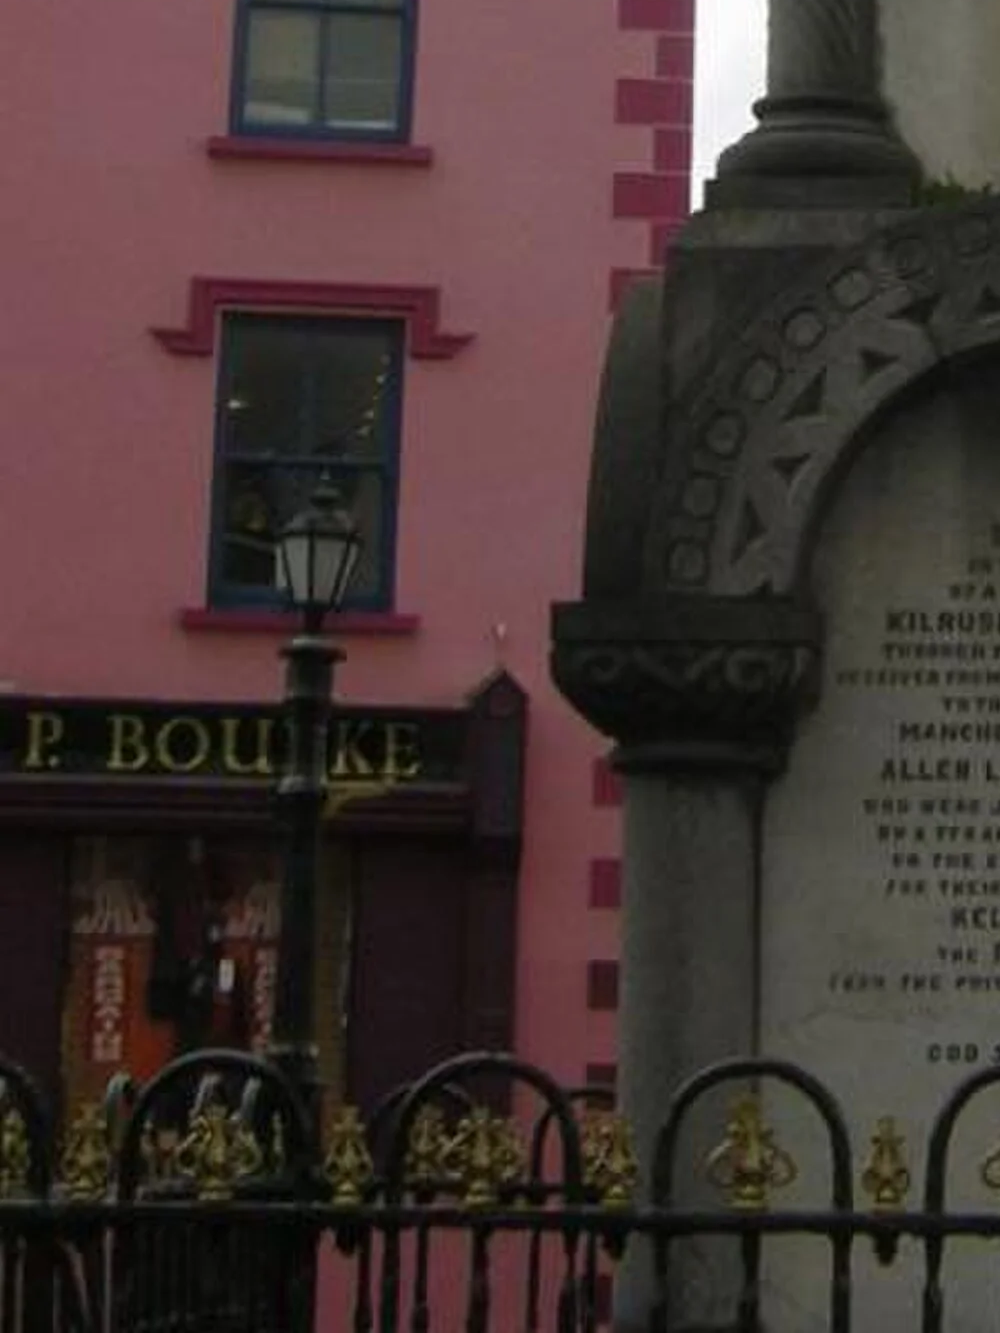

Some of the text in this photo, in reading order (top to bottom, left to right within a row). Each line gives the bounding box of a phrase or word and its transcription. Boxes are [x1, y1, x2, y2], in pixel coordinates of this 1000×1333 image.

[23, 710, 422, 777] P. BOUKE
[879, 758, 971, 784] ALLEN
[926, 1042, 979, 1066] GOD
